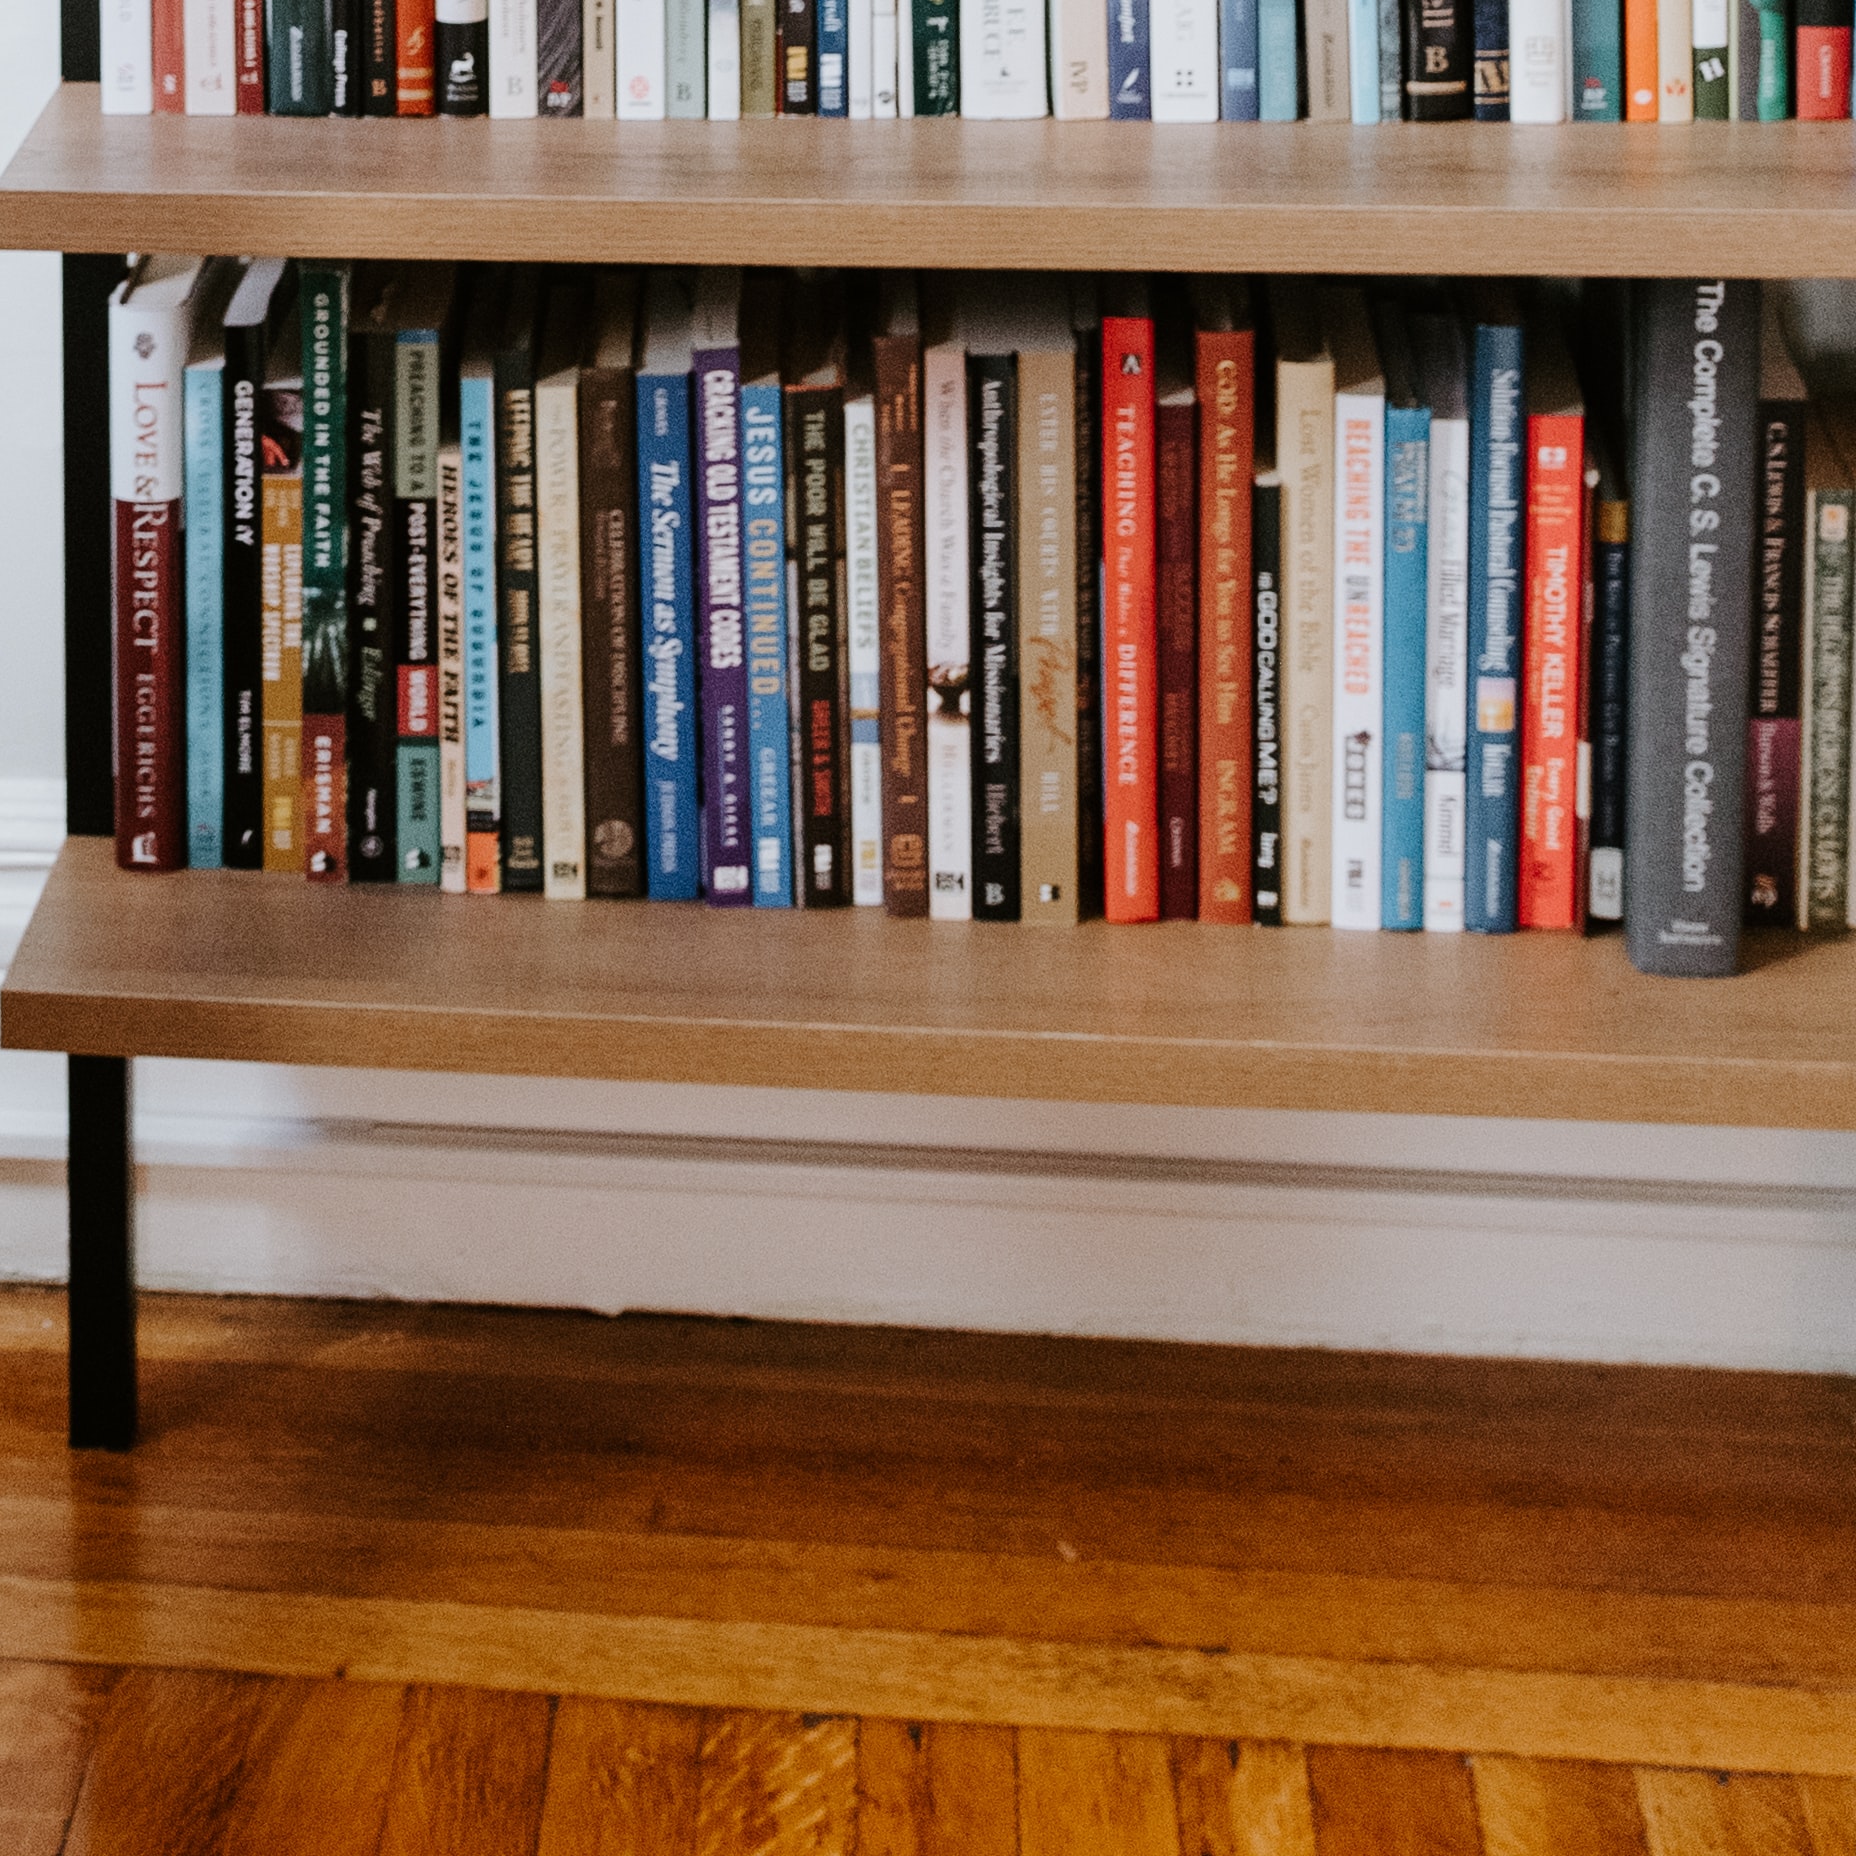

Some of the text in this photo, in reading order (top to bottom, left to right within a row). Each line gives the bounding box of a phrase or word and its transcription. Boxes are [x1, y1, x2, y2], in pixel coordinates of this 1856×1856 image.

[312, 293, 332, 569] GROUNDED IN THE FAITH
[703, 369, 742, 669] CRACKING OLD TESTAMENT CODES
[1114, 404, 1135, 537] TEACHING
[407, 502, 428, 732] POST-EVERYTHING WORLD
[441, 464, 460, 744] HEROES OF THE FAITH
[649, 459, 683, 761] The Sermon as Symphony
[1257, 590, 1278, 804] GOD CALLING ME?
[1681, 279, 1727, 892] The Complete C. S. Lewis Signature Collection
[134, 673, 158, 818] EGGERICHS
[1116, 643, 1138, 786] DIFFERENCE
